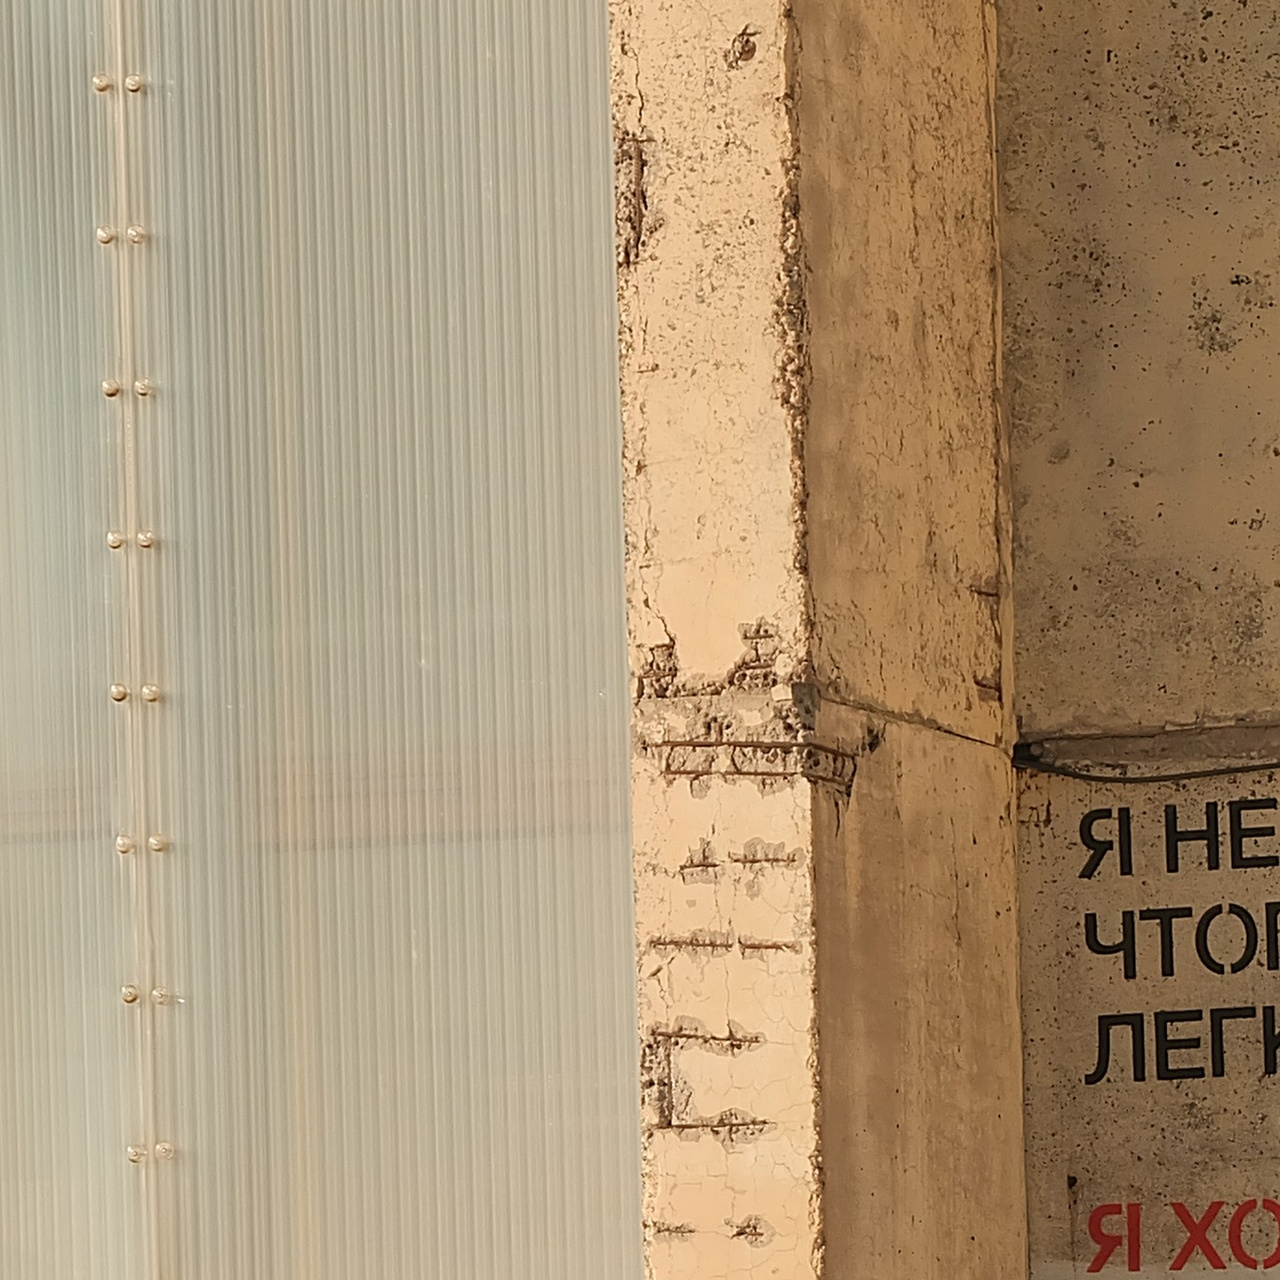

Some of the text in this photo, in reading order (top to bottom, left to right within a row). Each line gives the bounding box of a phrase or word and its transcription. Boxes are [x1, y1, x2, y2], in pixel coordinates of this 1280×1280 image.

[1077, 808, 1132, 879] Я
[1164, 798, 1279, 874] НЕ
[1086, 1202, 1141, 1273] Я
